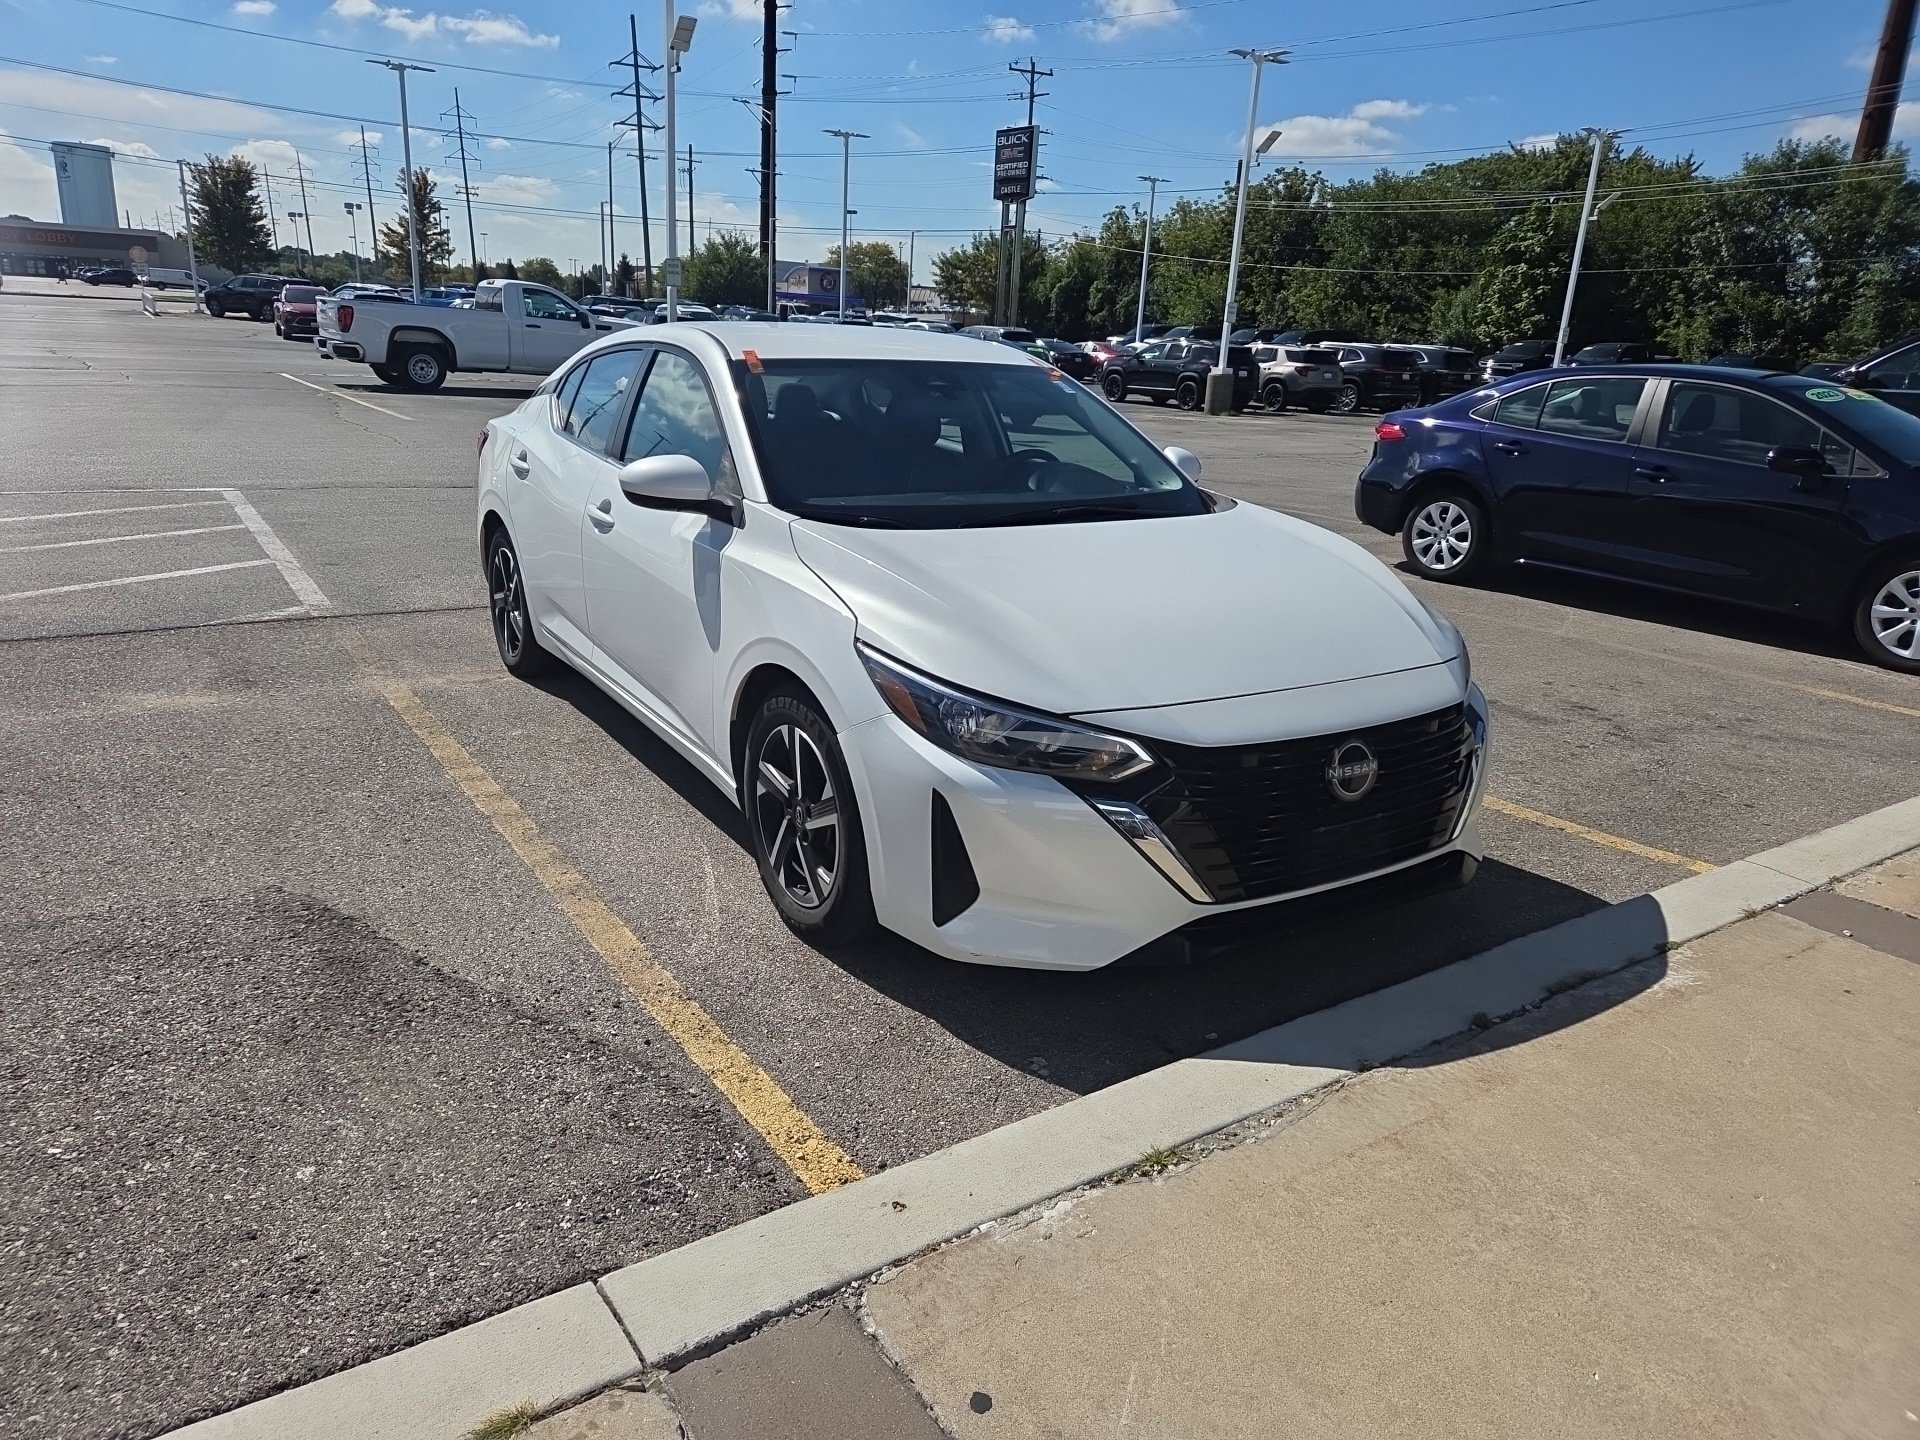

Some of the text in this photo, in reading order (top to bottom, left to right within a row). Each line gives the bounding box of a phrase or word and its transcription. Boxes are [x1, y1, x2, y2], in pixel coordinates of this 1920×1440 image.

[997, 133, 1030, 146] BUICK
[1001, 146, 1025, 160] GMC
[996, 161, 1029, 171] CERTIFIED
[997, 168, 1026, 177] PRE-OWNED
[1000, 185, 1021, 194] CASTLE
[26, 231, 77, 243] LOBBY
[1328, 760, 1376, 778] NISSAN
